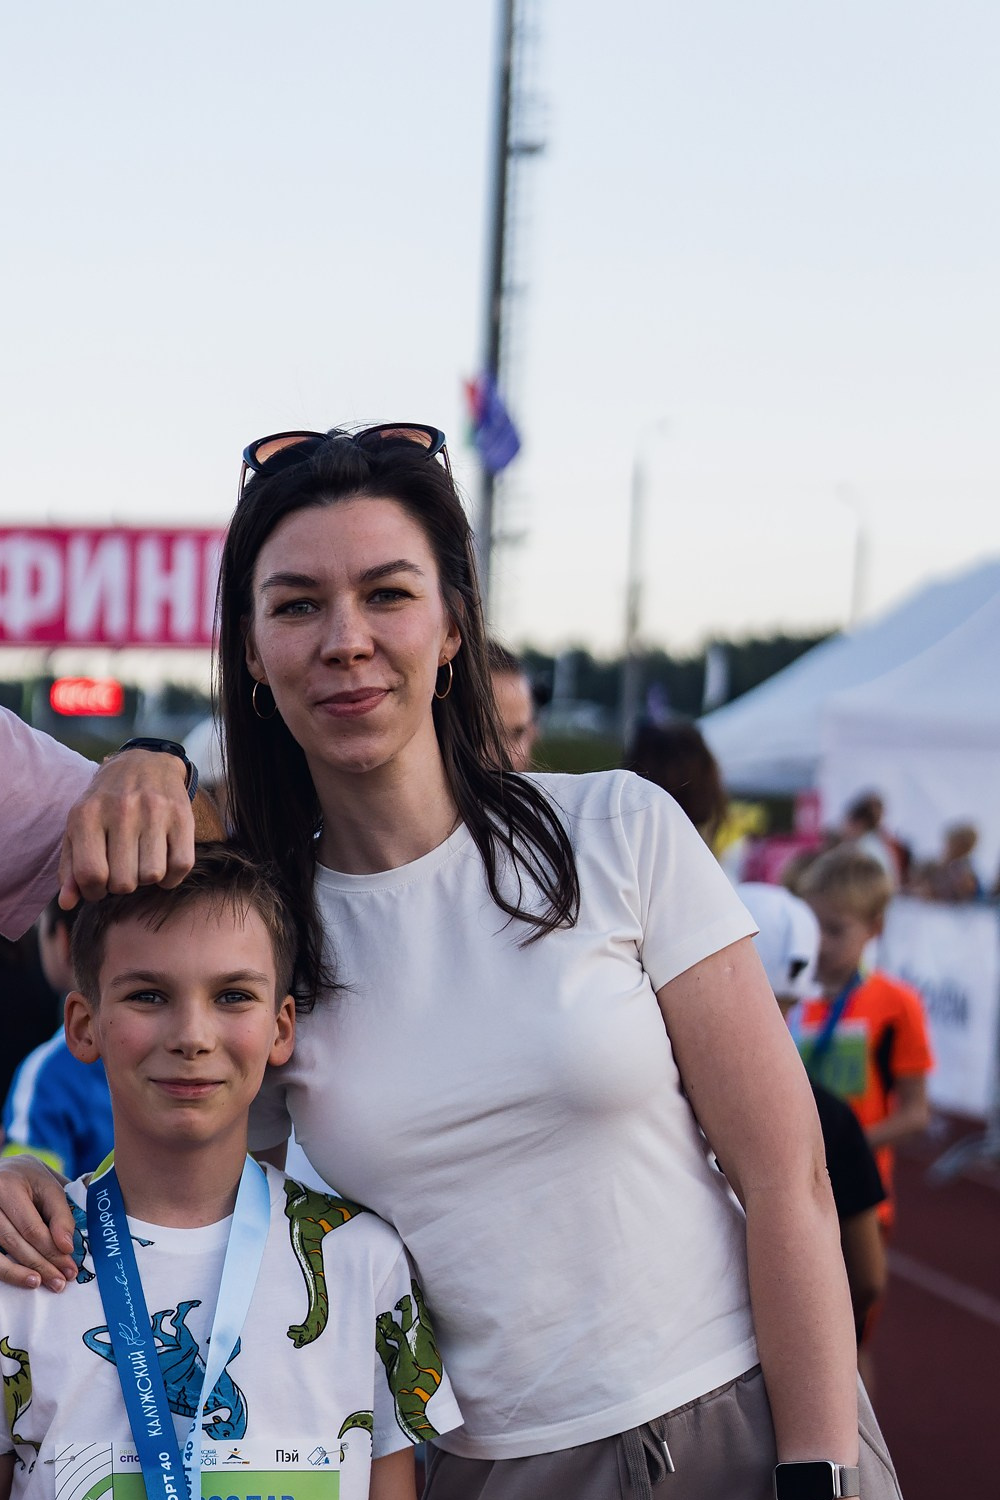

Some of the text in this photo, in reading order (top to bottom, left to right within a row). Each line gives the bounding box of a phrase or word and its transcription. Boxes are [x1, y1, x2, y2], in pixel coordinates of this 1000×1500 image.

[96, 1188, 122, 1258] МАРАФОН
[128, 1350, 163, 1437] КАЛУЖСКИЙ
[159, 1452, 172, 1471] 40
[184, 1441, 194, 1462] 40
[275, 1449, 299, 1463] Пэй
